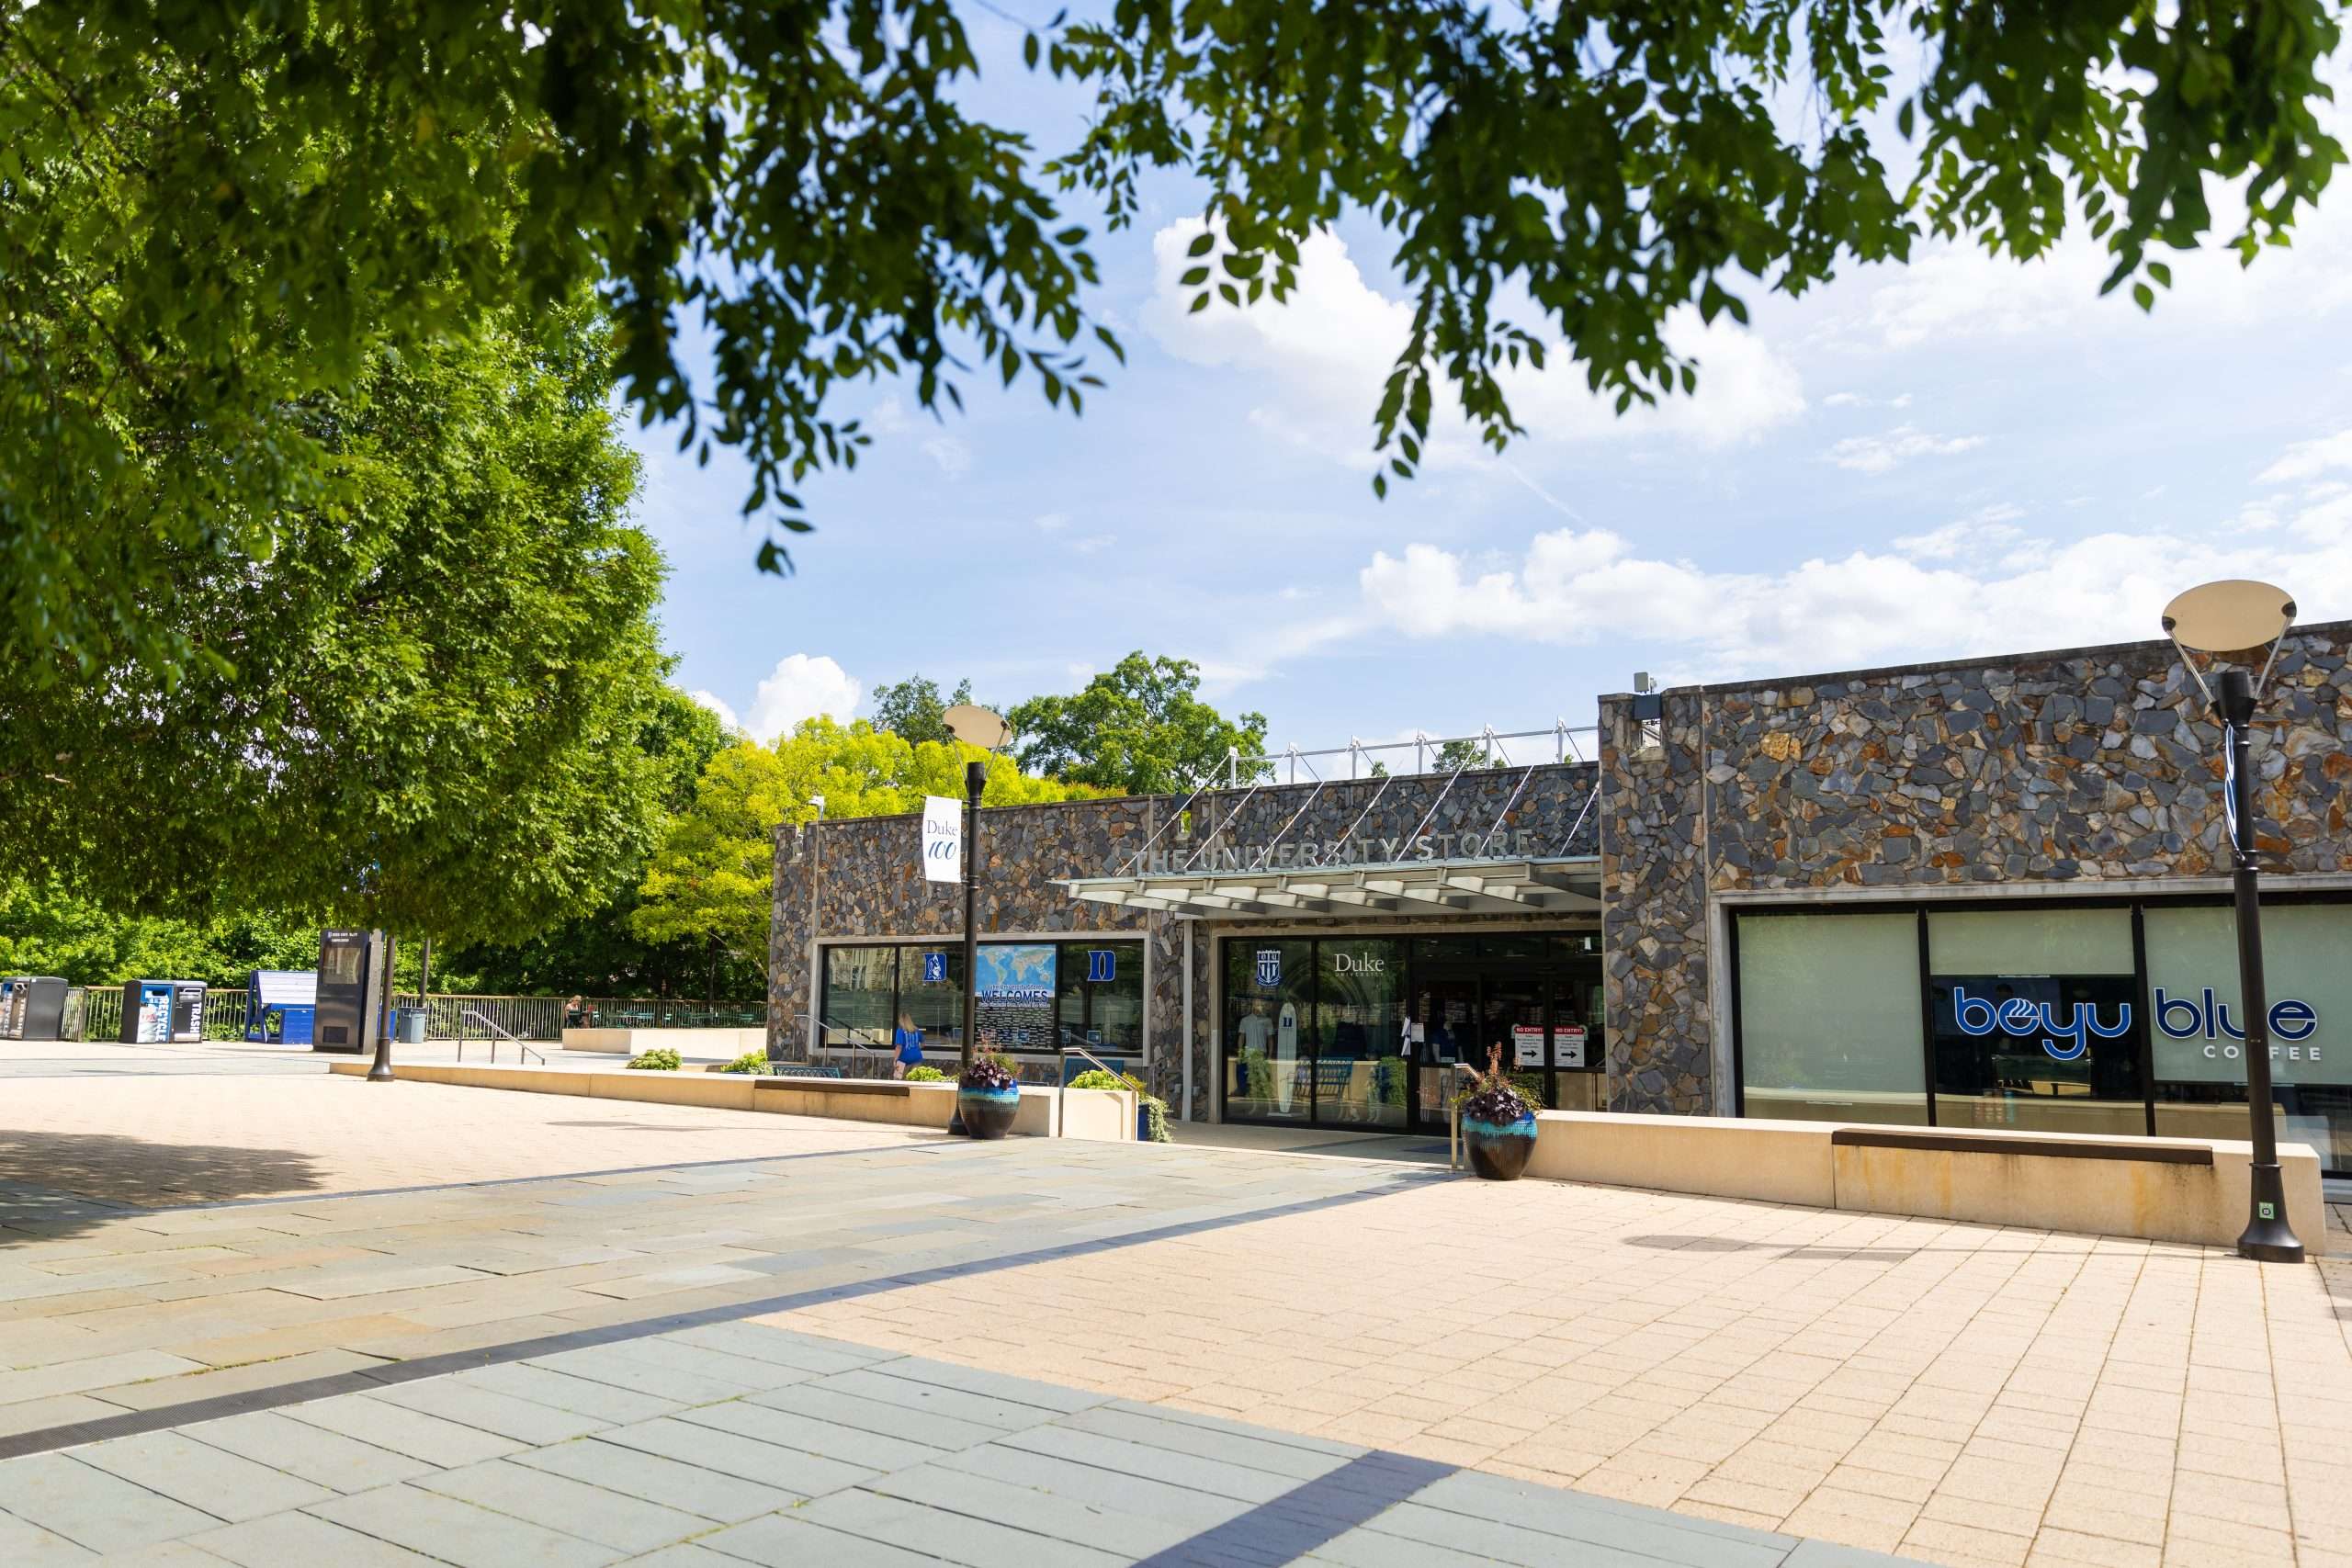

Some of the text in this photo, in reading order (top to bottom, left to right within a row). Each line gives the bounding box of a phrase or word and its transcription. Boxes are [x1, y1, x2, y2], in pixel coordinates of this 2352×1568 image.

[926, 819, 958, 837] Duke
[928, 840, 957, 861] 100
[1132, 829, 1533, 875] THE UNIVERSITY STORE
[1334, 952, 1385, 972] Duke
[980, 990, 1048, 1004] WELCOMES
[17, 998, 27, 1030] TRASH
[155, 998, 170, 1042] RECYCLE
[189, 1002, 202, 1034] TRASH
[1954, 987, 2132, 1061] beyu
[2203, 1044, 2322, 1061] COFEE
